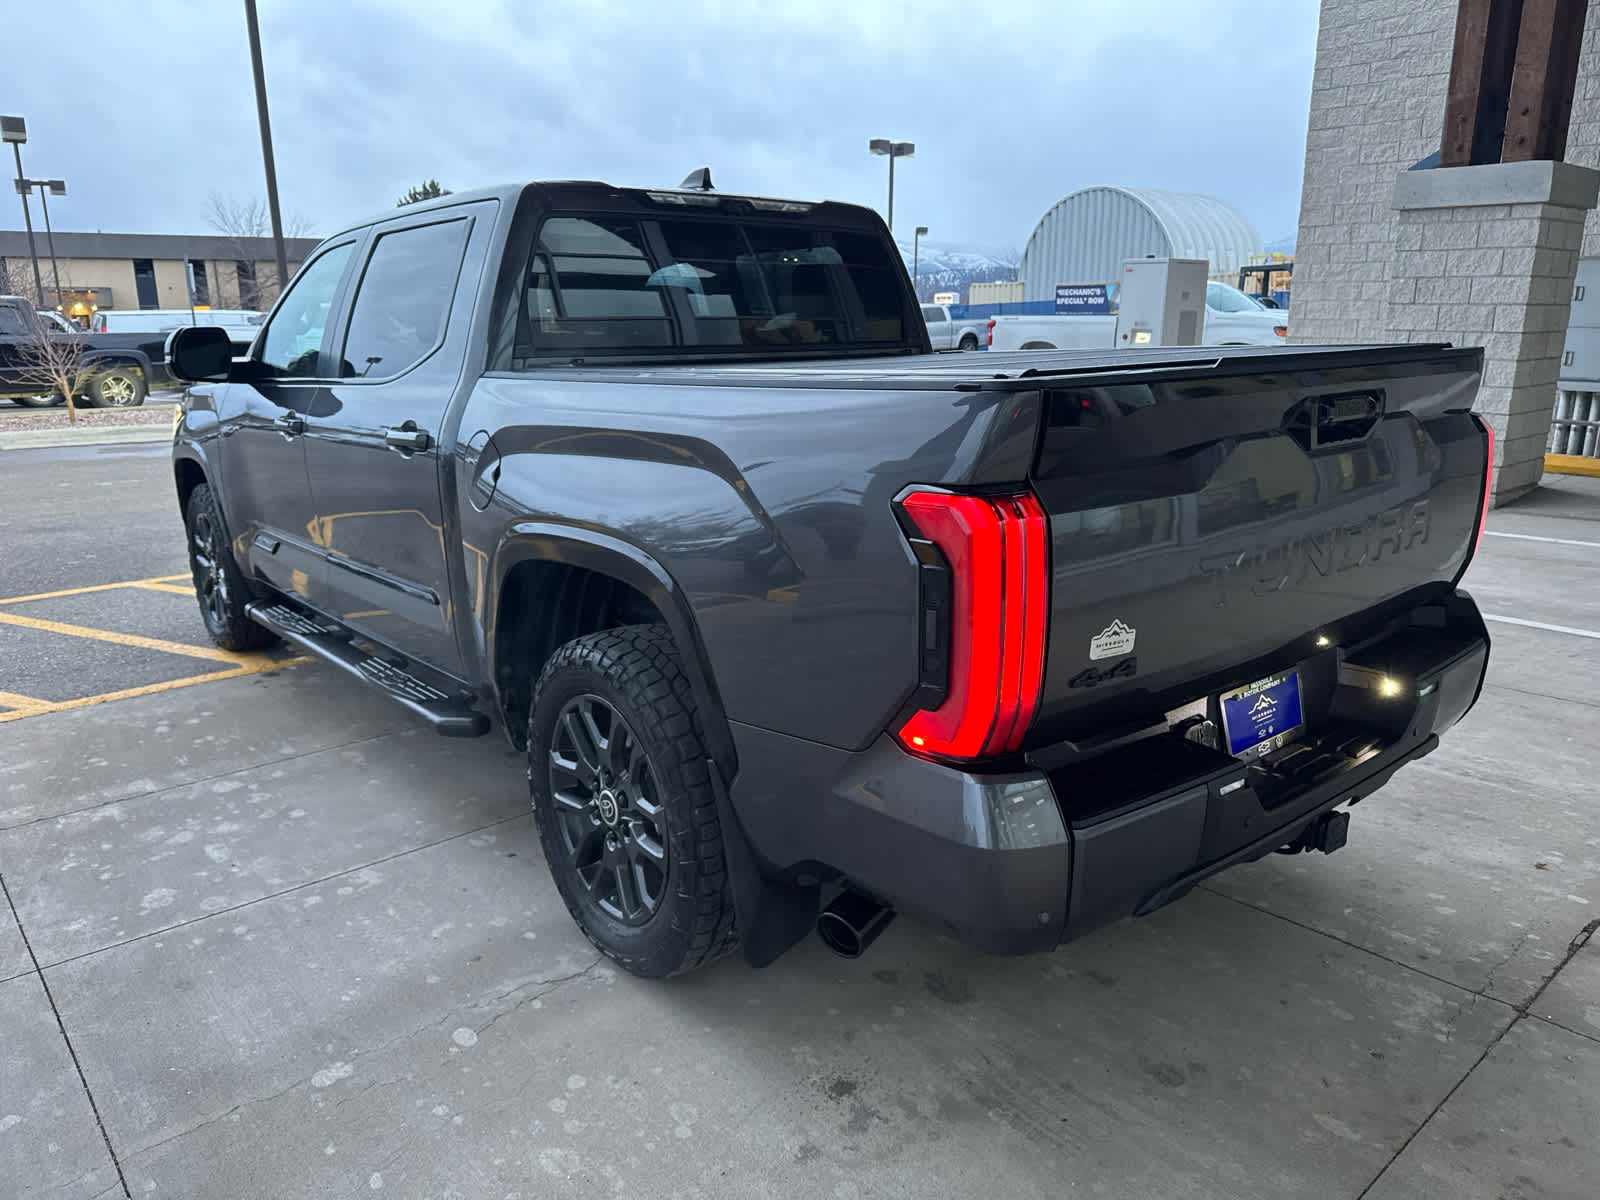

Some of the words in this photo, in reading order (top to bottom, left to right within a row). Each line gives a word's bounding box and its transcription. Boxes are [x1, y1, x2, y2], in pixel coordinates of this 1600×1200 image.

[1088, 296, 1105, 304] ROW
[1199, 499, 1432, 608] TUNDRA
[1261, 679, 1280, 691] COMPANY
[1252, 707, 1276, 720] MISSOULA
